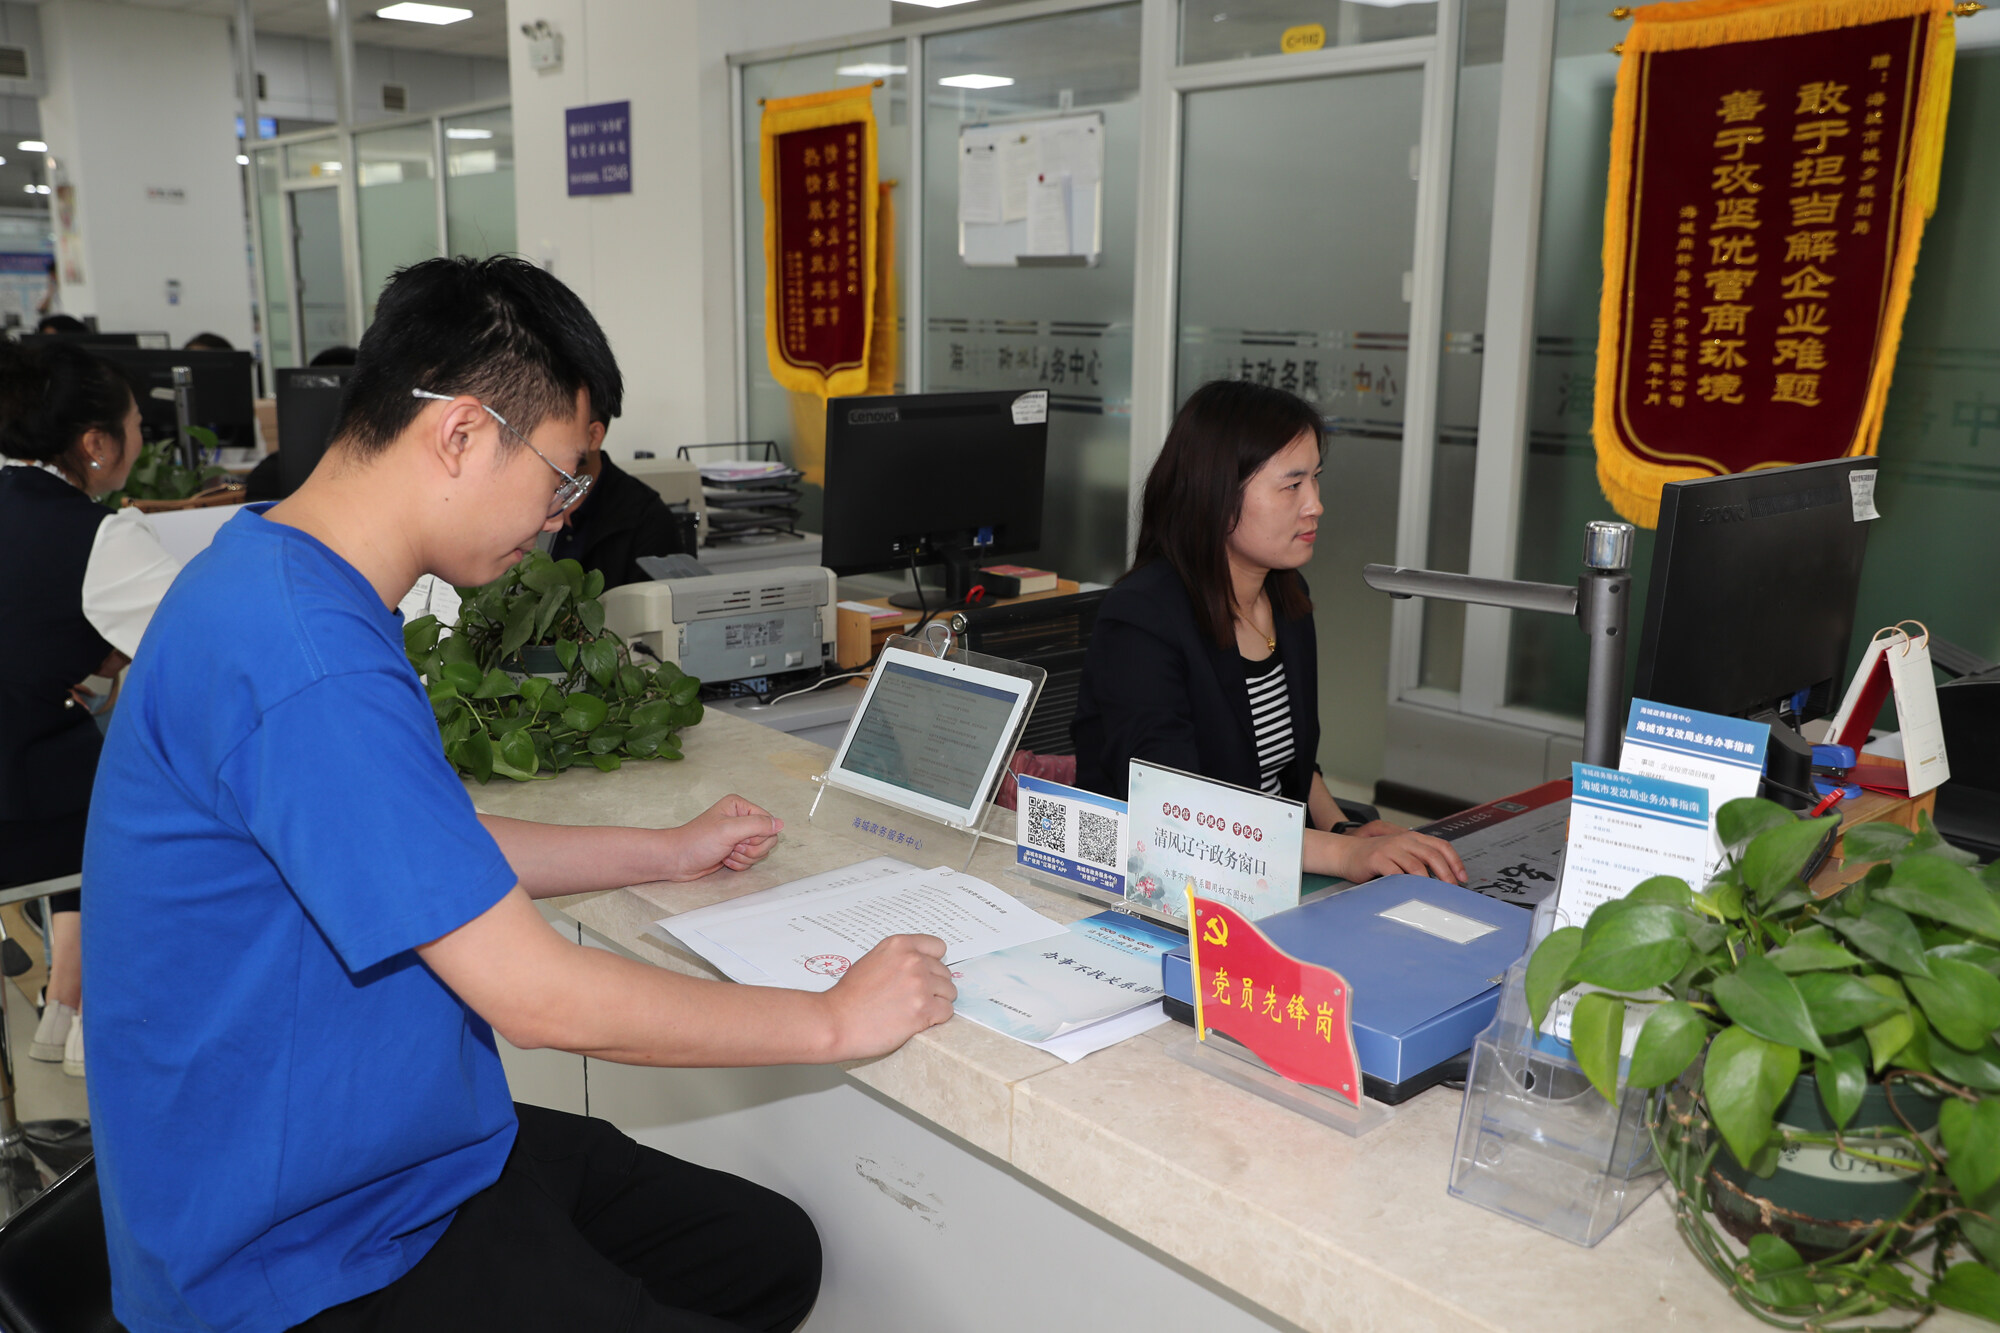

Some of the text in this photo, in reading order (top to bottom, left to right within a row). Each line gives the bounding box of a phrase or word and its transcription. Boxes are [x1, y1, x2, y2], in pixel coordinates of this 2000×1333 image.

[1696, 88, 1768, 406] 善于攻坚优营商环境
[1771, 80, 1851, 407] 敢于担当解企业难题
[849, 410, 899, 424] Lenovo
[1697, 503, 1745, 523] Lenovo
[1639, 706, 1692, 724] 海城政务服务中心
[1635, 720, 1755, 755] 海城市发改局业务办事指南
[1581, 767, 1633, 785] 海城政务服务中心
[1580, 779, 1700, 814] 海城市发改局业务办事指南
[851, 816, 924, 851] 海城政务服务中心
[1163, 802, 1263, 843] 讲诚信 懂规矩 守纪律
[1154, 826, 1267, 877] 清风辽宁政务窗口
[1211, 966, 1335, 1045] 党员先锋岗
[1829, 1146, 1922, 1174] GAR
